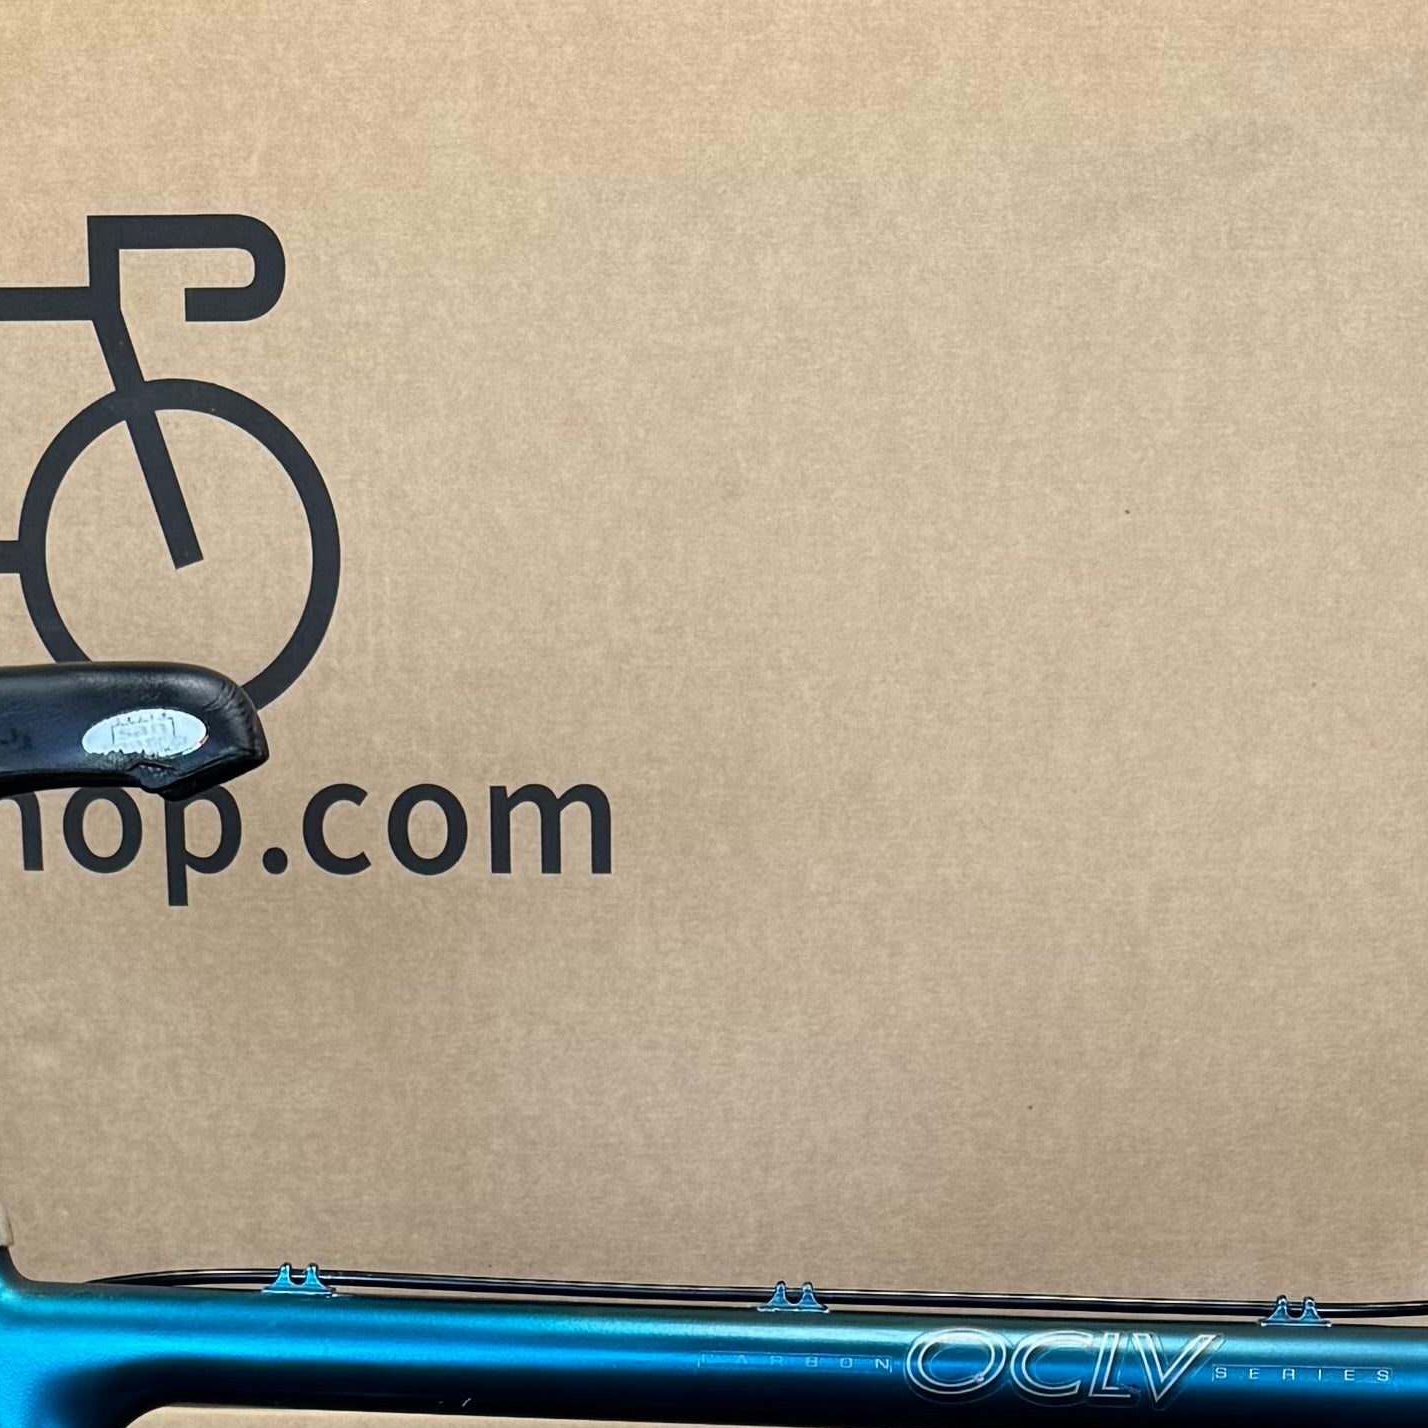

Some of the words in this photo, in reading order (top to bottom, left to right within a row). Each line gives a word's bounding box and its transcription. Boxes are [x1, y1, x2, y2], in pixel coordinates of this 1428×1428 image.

[699, 1352, 891, 1371] CARBON
[905, 1327, 1223, 1404] OCLV
[1213, 1366, 1392, 1384] SERIES
